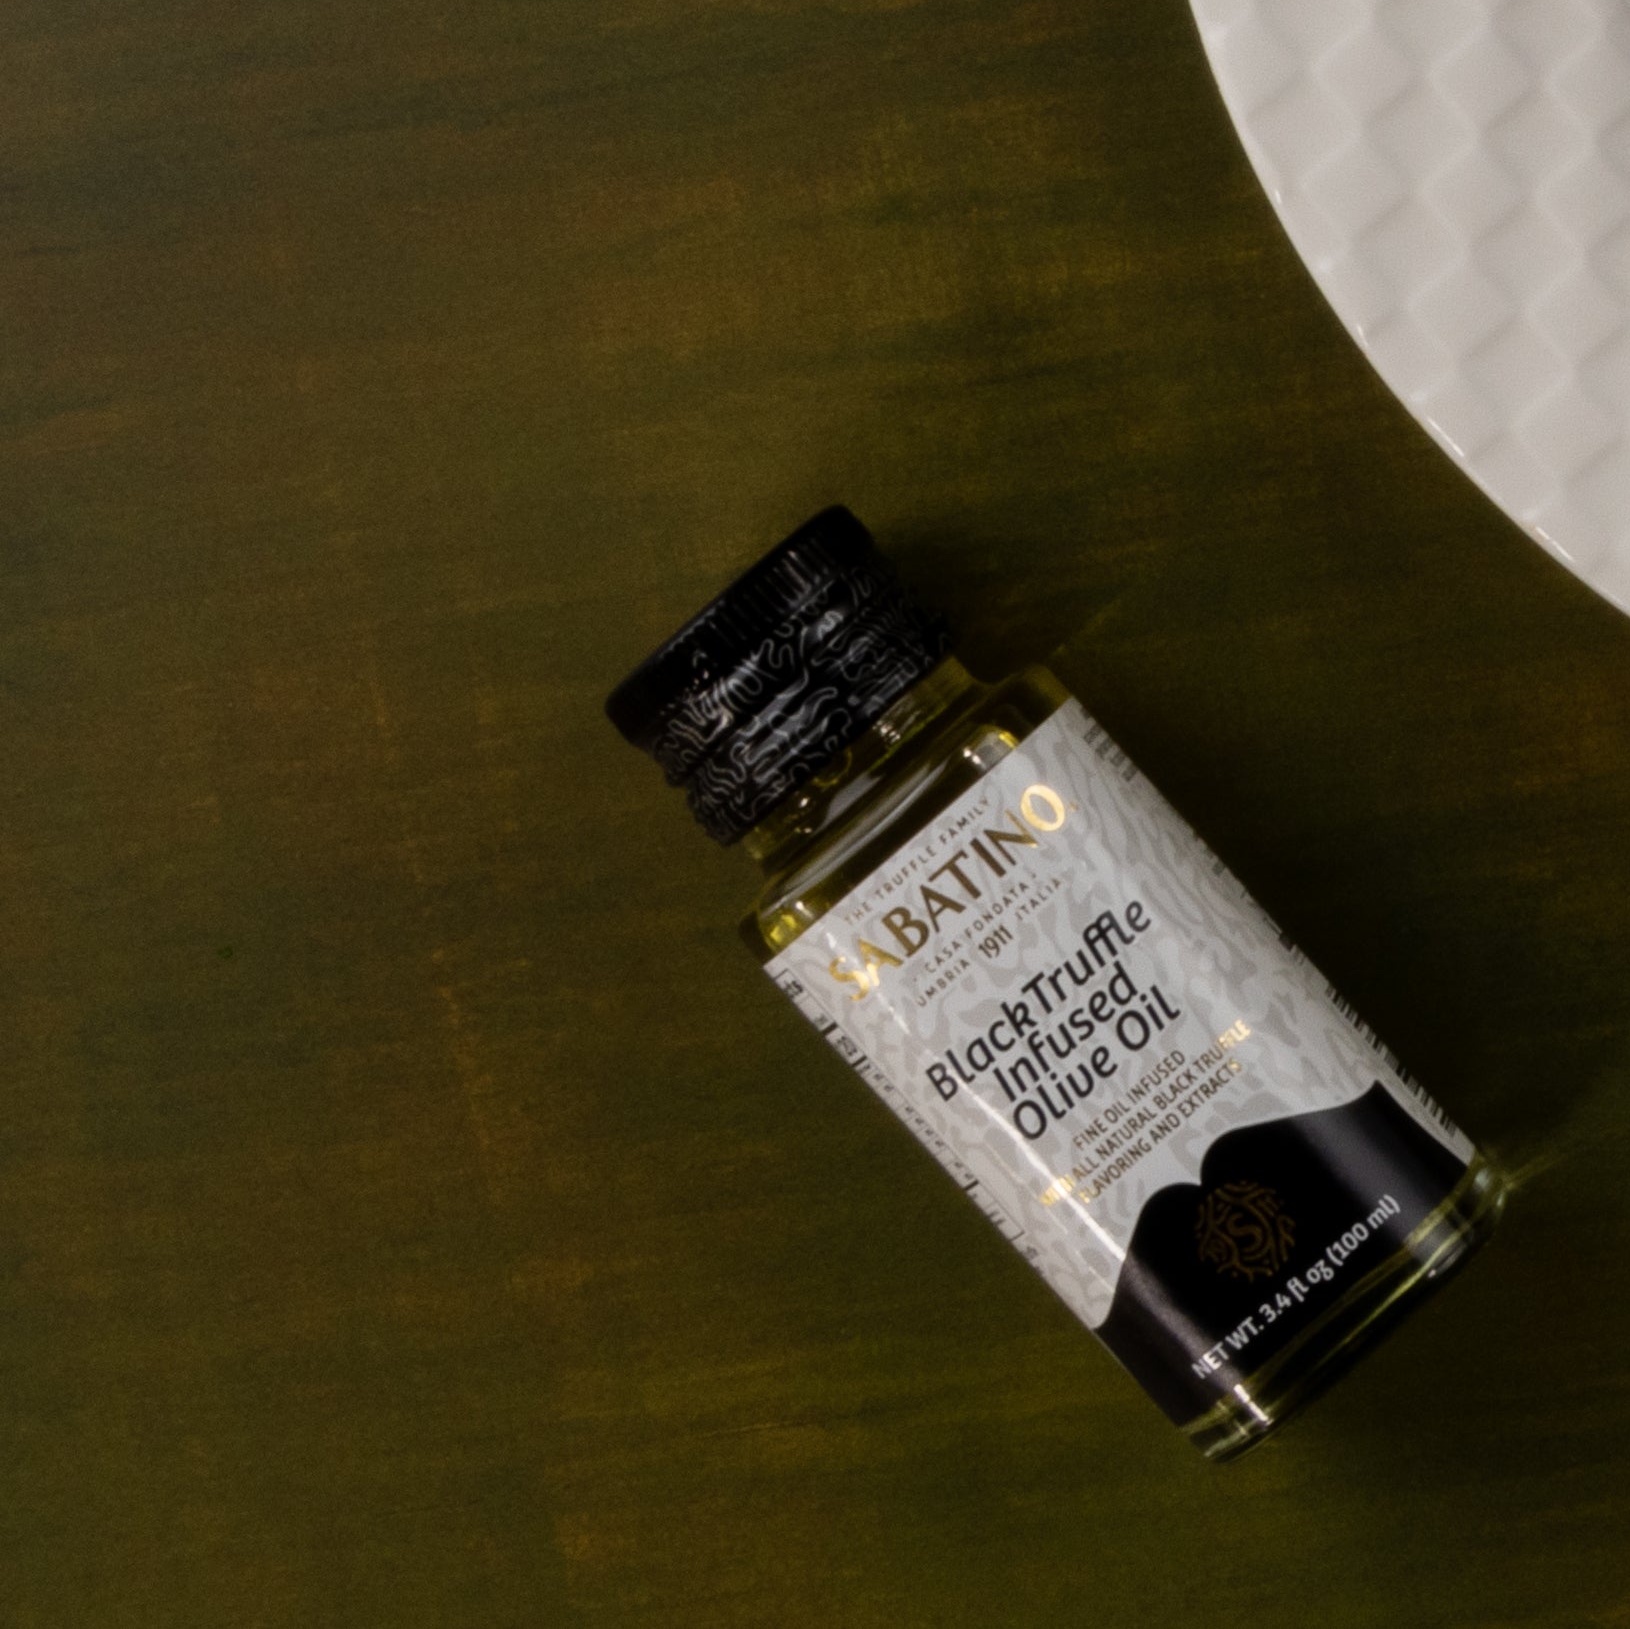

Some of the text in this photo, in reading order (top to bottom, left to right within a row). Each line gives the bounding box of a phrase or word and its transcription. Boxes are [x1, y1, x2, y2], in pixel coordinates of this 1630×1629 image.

[828, 785, 1065, 1002] SABATINO
[842, 796, 990, 926] THE TRUFFLE FAMILY
[923, 881, 1029, 973] CASA FONDATA
[917, 877, 1061, 1007] UMBRIA 1911 ITALIA
[993, 961, 1137, 1101] Infused
[1012, 1046, 1117, 1139] Olive
[1115, 985, 1180, 1051] Oil
[1071, 1156, 1100, 1181] ALL
[1094, 1107, 1157, 1160] NATURAL
[1152, 1068, 1197, 1110] BLACK
[1191, 1018, 1251, 1073] TRUFFLE
[1072, 1049, 1185, 1148] FINE OIL INFUSED
[1079, 1059, 1241, 1203] FLAVORING AND EXTRACTS
[1192, 1193, 1401, 1377] NET WT. 3.4 fl oz (100 ml)
